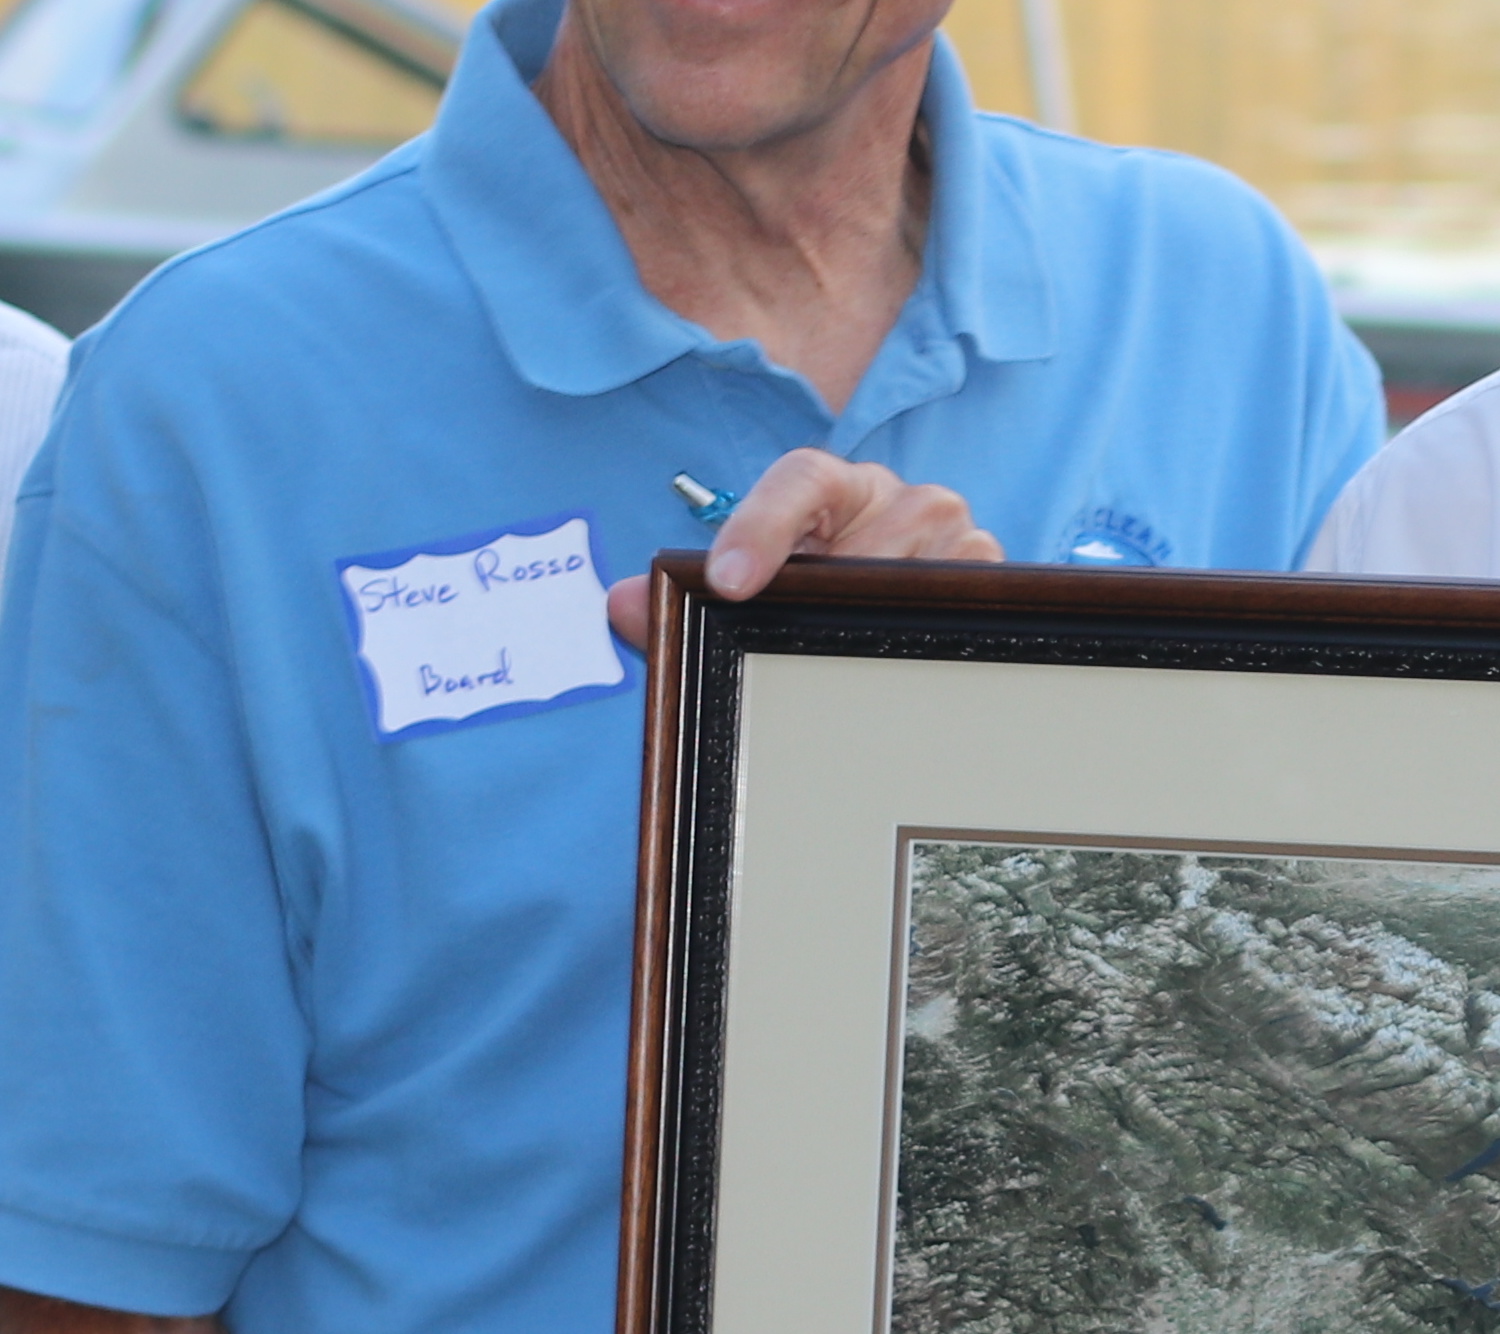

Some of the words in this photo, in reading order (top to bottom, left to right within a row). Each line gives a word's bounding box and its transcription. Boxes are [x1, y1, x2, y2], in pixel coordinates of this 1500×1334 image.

[358, 576, 459, 614] Steve
[474, 548, 586, 593] Rosso
[418, 646, 515, 697] Board
